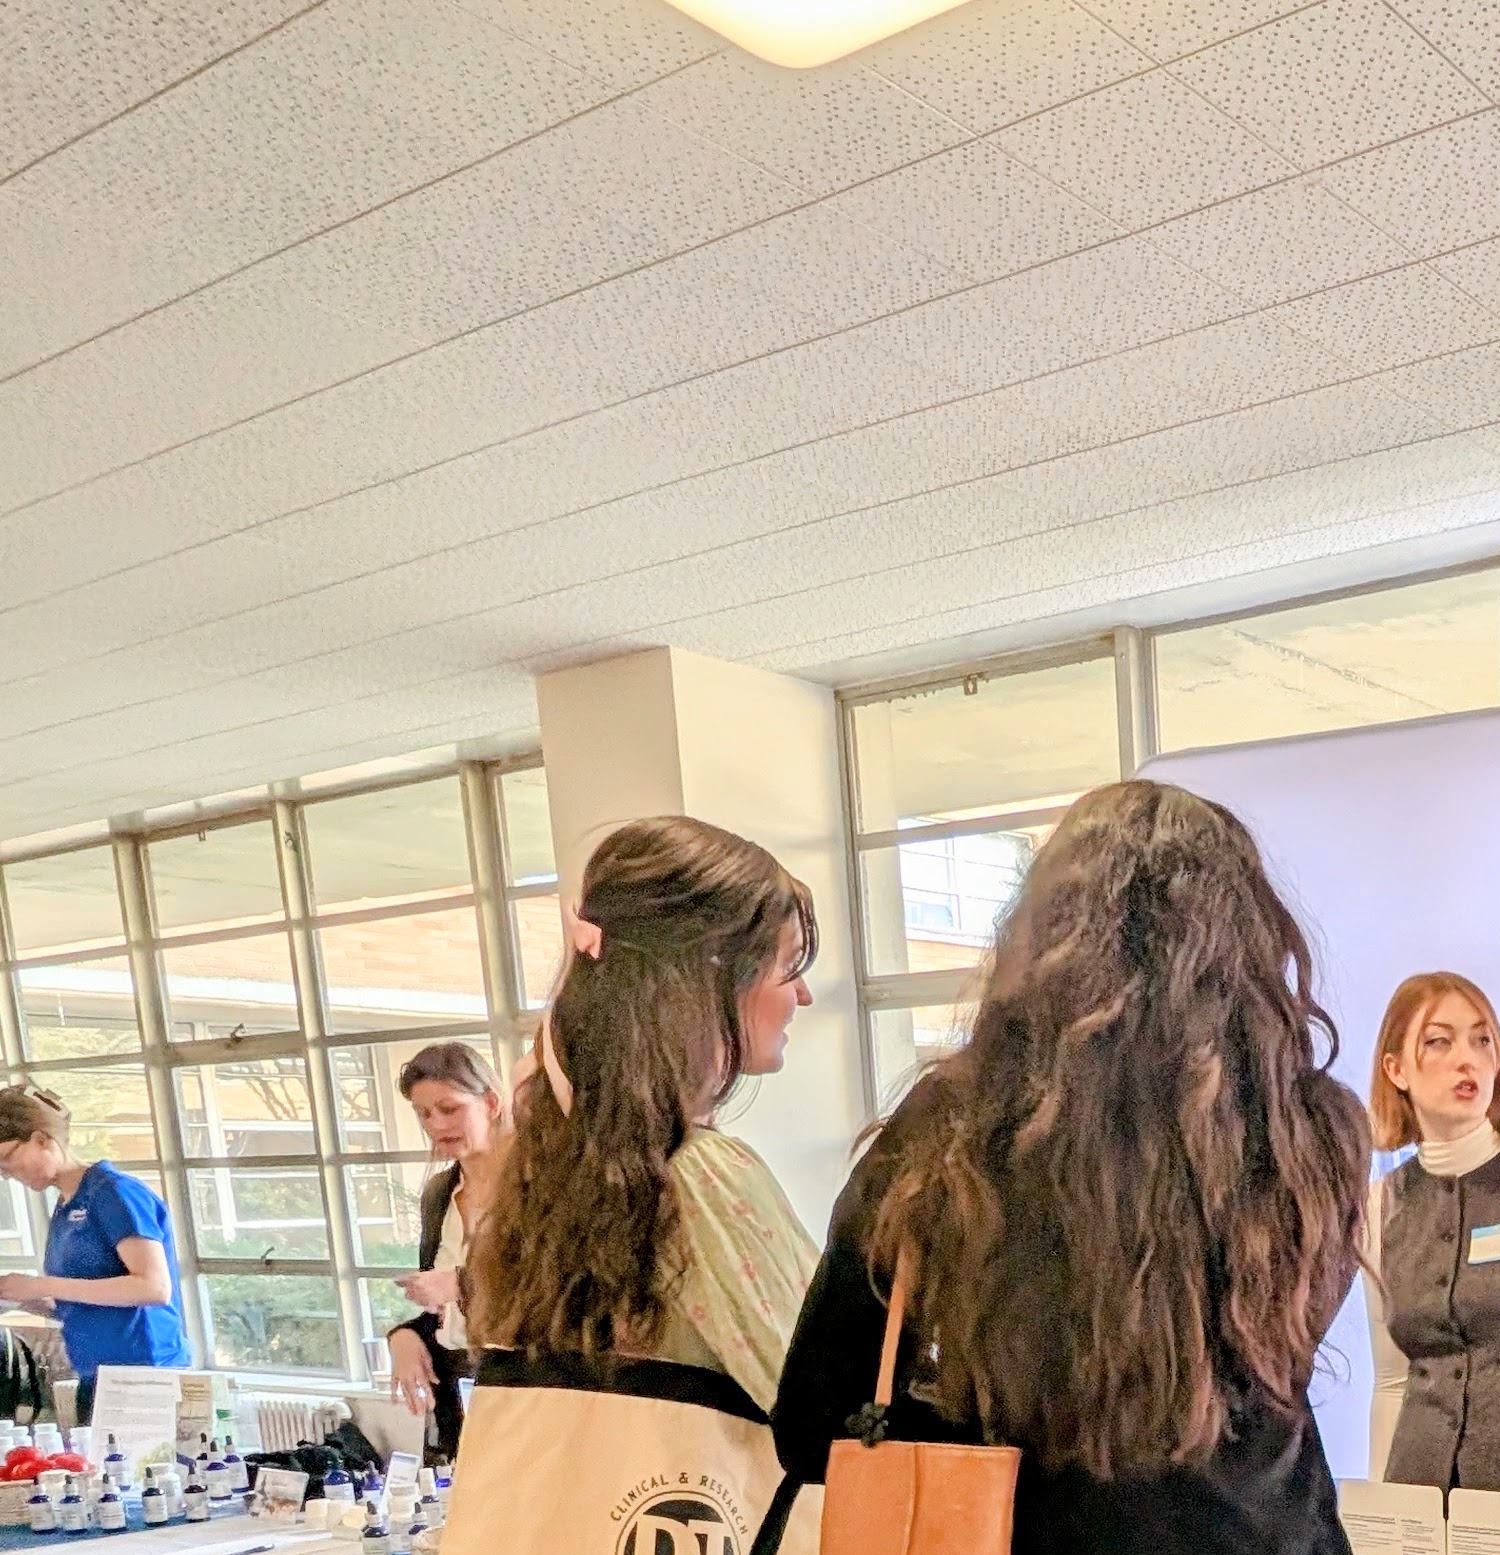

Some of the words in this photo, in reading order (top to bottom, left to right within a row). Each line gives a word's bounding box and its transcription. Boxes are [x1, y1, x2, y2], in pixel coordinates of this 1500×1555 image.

[610, 1474, 670, 1522] CLINICAL
[678, 1472, 689, 1485] &
[700, 1474, 749, 1536] RESEARCH
